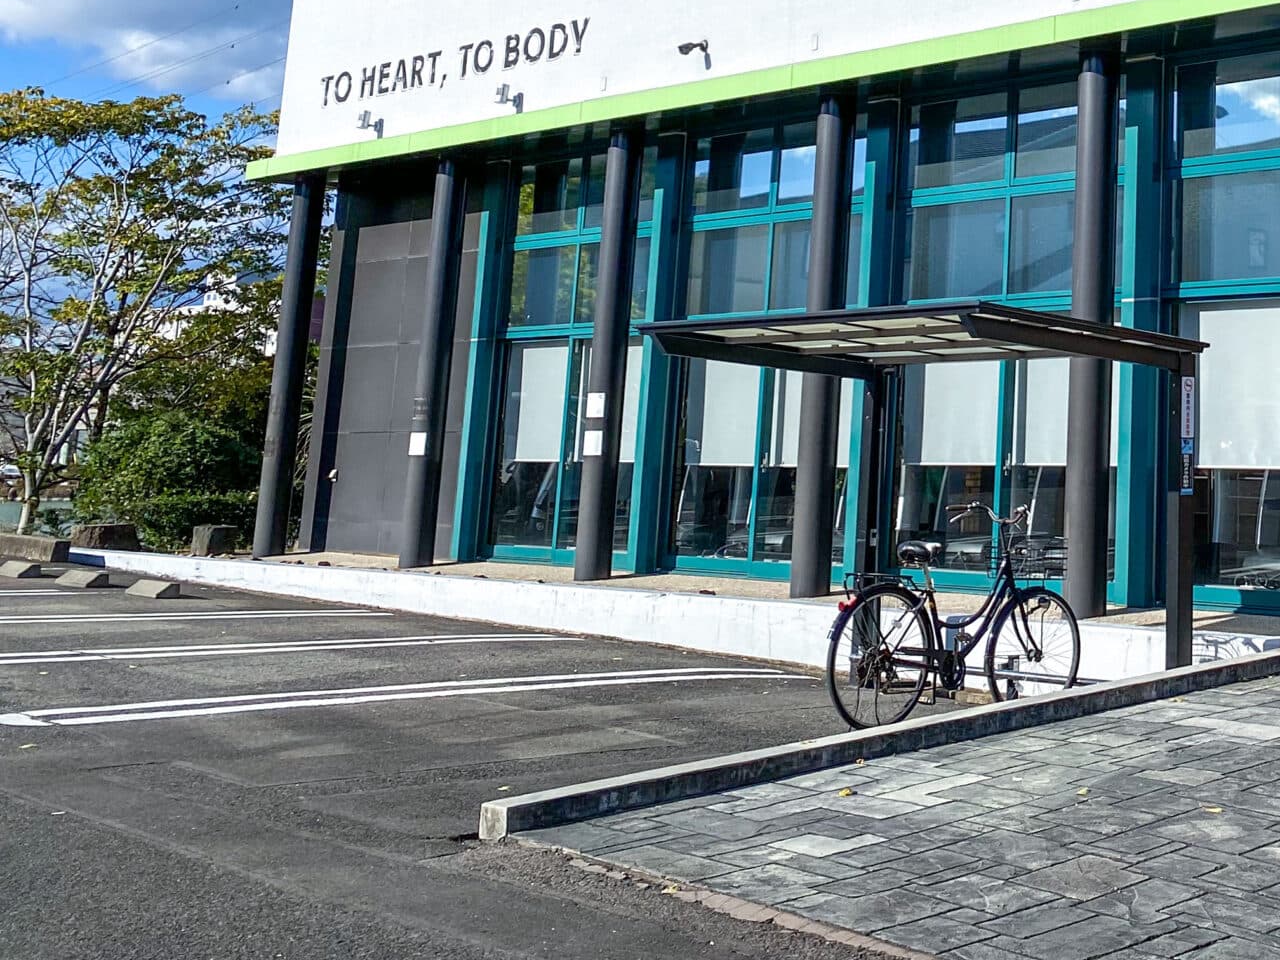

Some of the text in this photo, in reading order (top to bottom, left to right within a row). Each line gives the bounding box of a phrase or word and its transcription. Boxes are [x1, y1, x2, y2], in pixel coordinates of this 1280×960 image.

[321, 16, 591, 108] TO HEART, TO BODY
